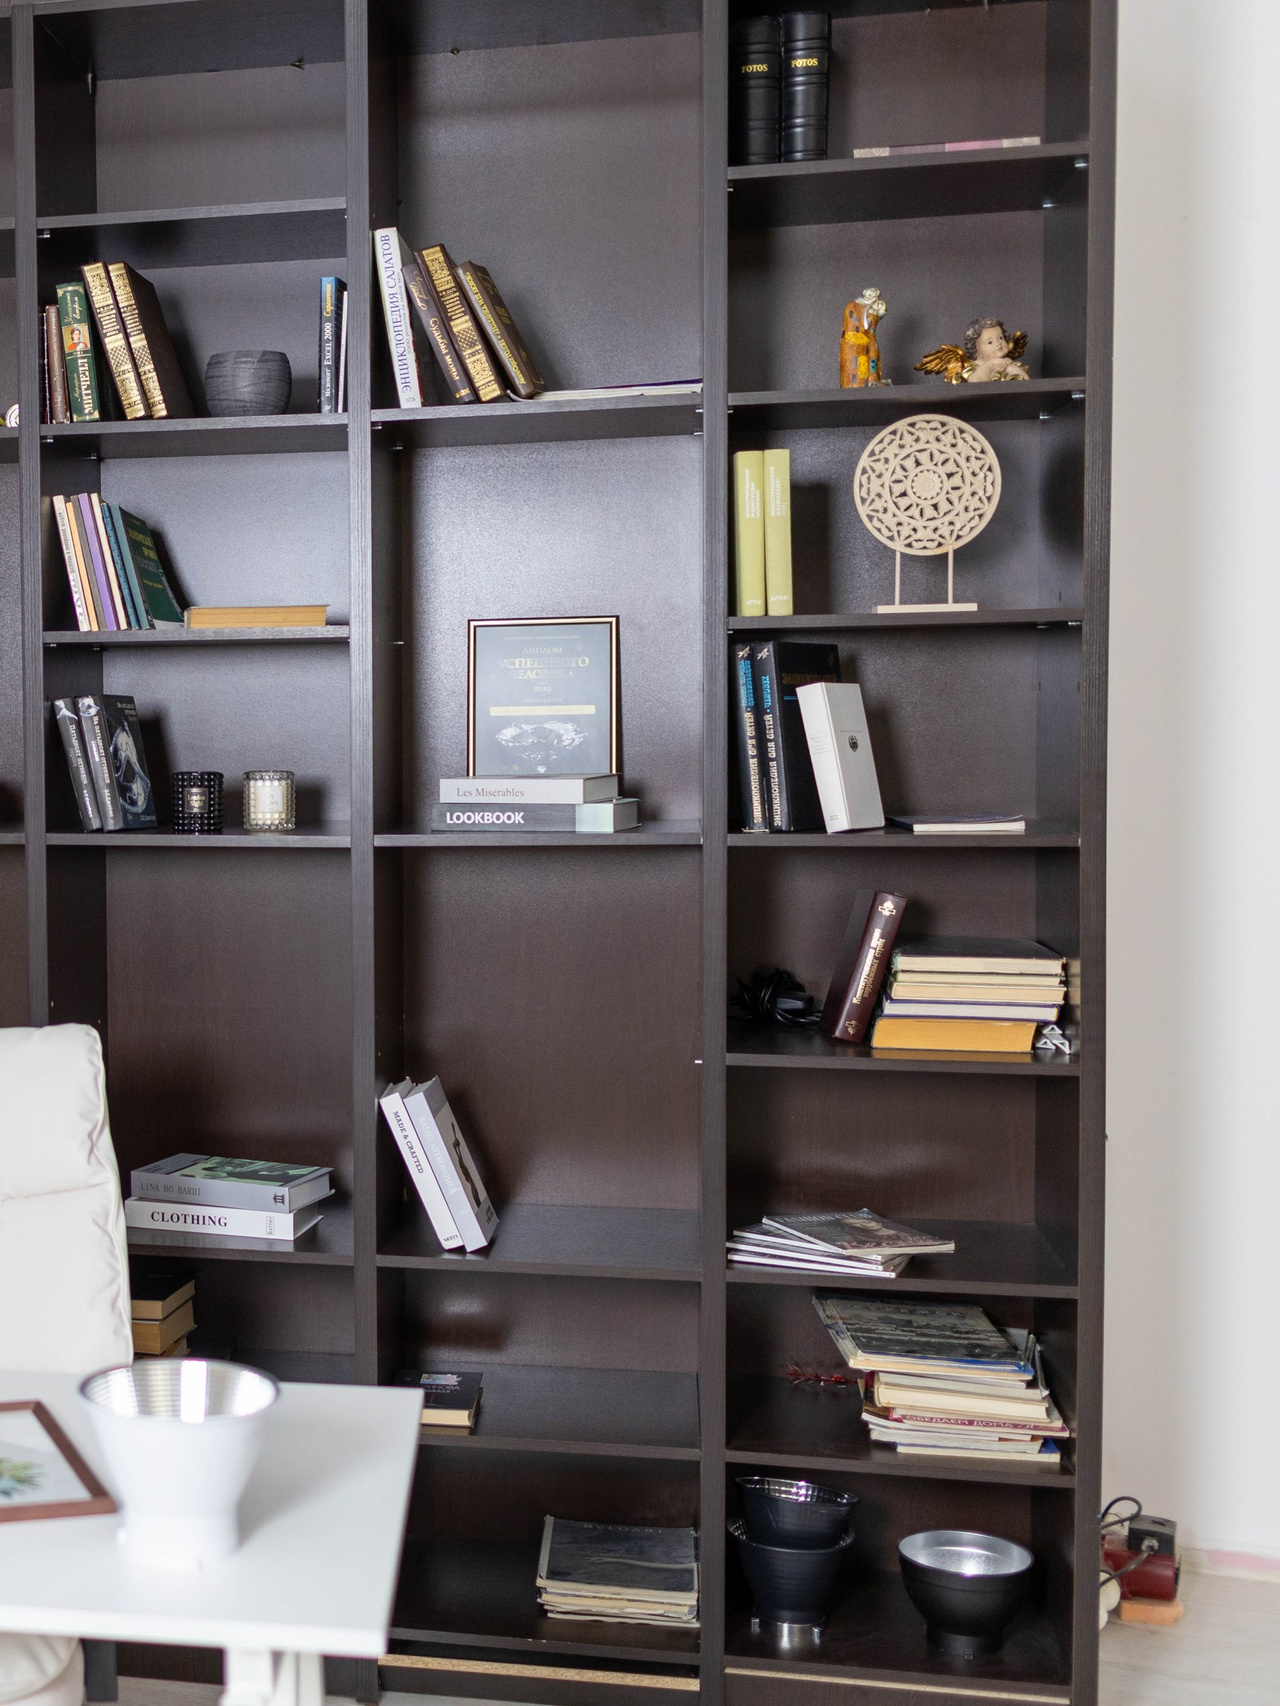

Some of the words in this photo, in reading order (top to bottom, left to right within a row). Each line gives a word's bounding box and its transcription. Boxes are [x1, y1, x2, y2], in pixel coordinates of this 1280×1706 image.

[742, 64, 768, 73] FOTOS
[791, 58, 818, 68] FOTOS
[380, 234, 396, 289] САЛАТОВ
[71, 295, 83, 319] ветром
[323, 322, 332, 340] 2000
[391, 292, 410, 393] ЭНЦИКЛОПЕДИЯ
[429, 317, 449, 355] Судьбы
[445, 355, 460, 381] моды
[77, 357, 94, 413] МИТЧЕЛЛ
[522, 646, 562, 654] ДИПЛОМ
[533, 685, 552, 694] 2019
[746, 711, 755, 736] ДЕТЕЙ
[764, 713, 774, 739] ДЕТЕЙ
[748, 738, 756, 755] ДЛЯ
[767, 741, 776, 758] ДЛЯ
[456, 788, 472, 797] Les
[475, 787, 524, 798] Miserables
[749, 757, 761, 823] ЭНЦИКЛОПЕДИЯ
[769, 760, 782, 826] ЭНЦИКЛОПЕДИЯ
[446, 812, 524, 824] LOOKBOOK
[863, 957, 879, 998] зарубежных
[392, 1110, 407, 1133] MADE
[405, 1140, 424, 1174] CRAFTED
[418, 1115, 433, 1141] RADIO
[430, 1141, 458, 1194] ASTRONOMER
[141, 1182, 160, 1193] LINA
[163, 1184, 174, 1194] BO
[177, 1185, 201, 1196] BARDI
[151, 1211, 228, 1227] CLOTHING
[906, 1415, 970, 1428] ОБЕДАЕМ
[973, 1419, 1014, 1429] ДОМА
[583, 1524, 662, 1534] BVLGARI
